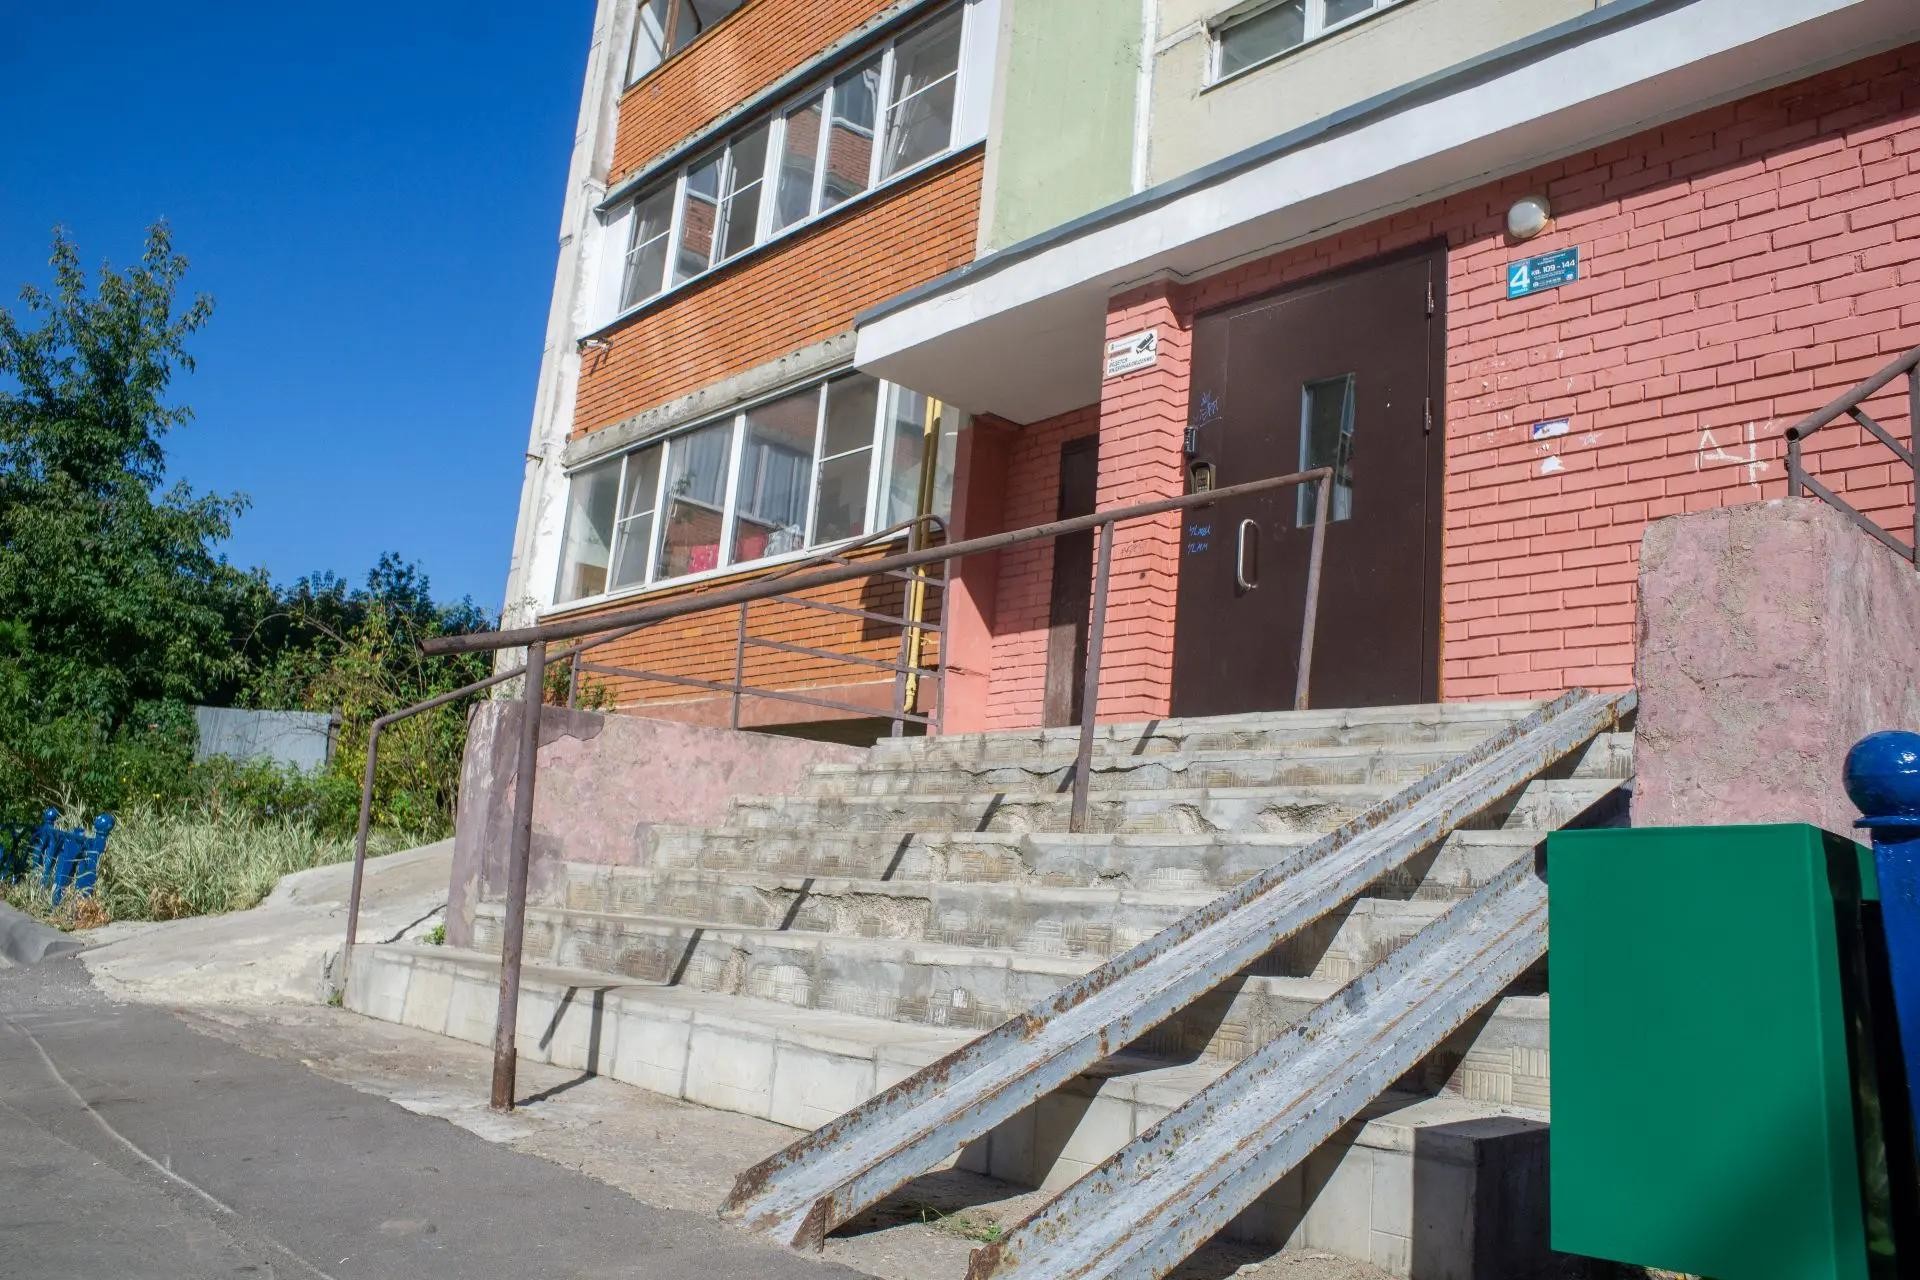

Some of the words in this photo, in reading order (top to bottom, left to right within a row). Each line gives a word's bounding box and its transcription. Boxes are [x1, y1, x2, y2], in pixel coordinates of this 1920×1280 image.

[1543, 264, 1555, 273] 109
[1562, 259, 1575, 268] 144
[1510, 265, 1530, 288] 4
